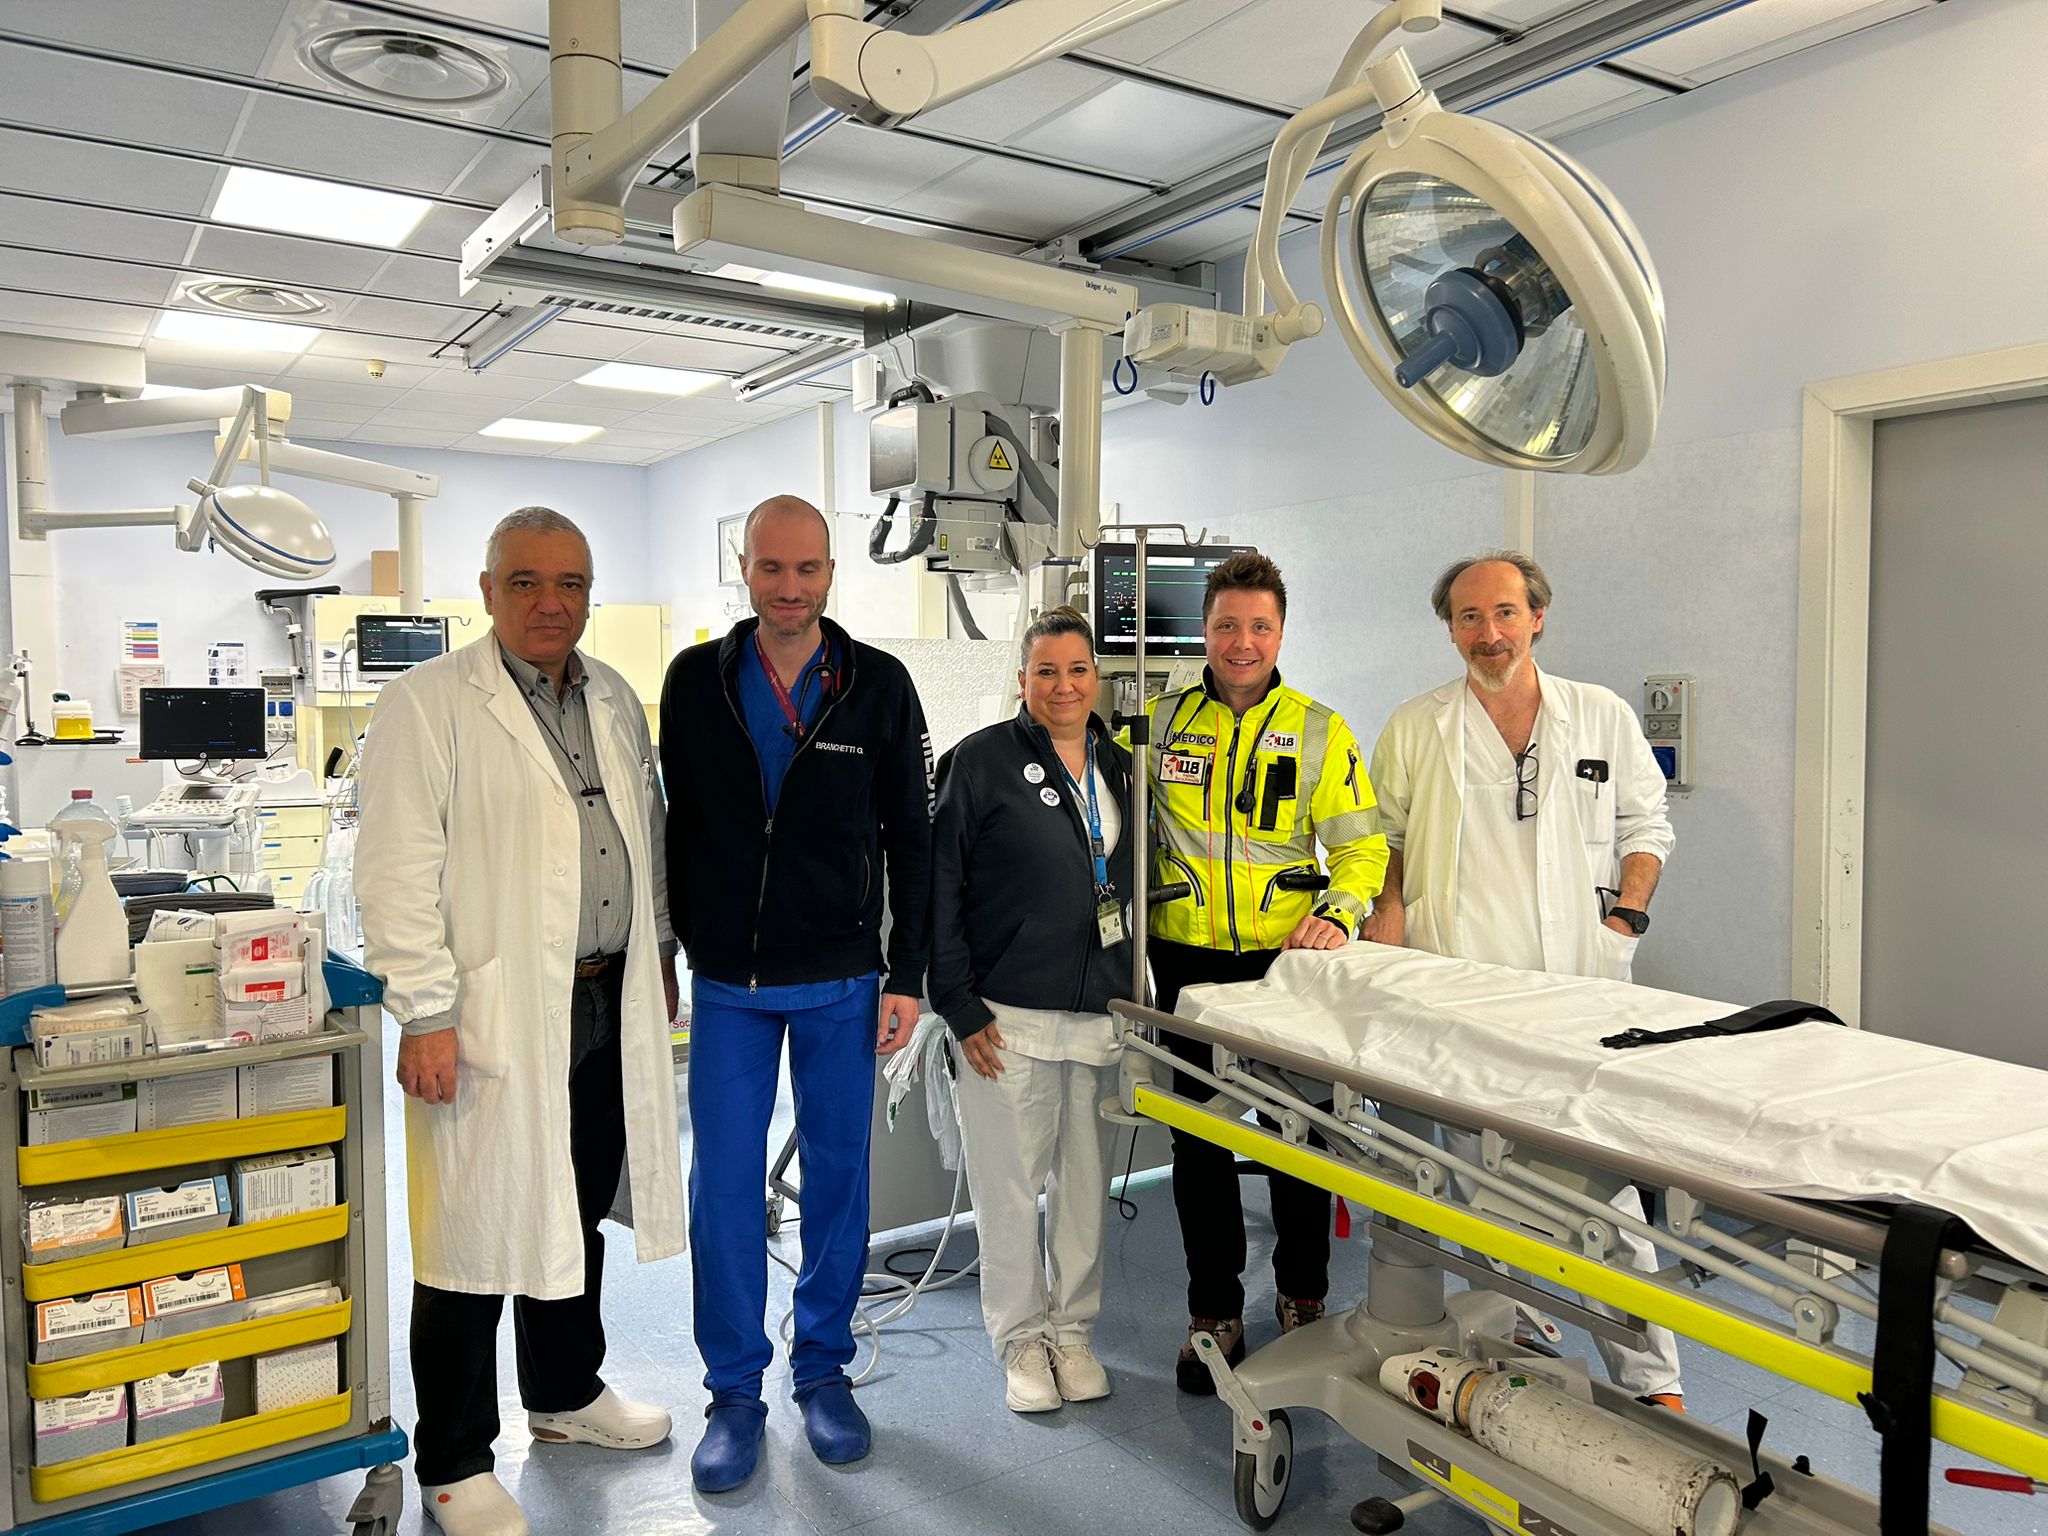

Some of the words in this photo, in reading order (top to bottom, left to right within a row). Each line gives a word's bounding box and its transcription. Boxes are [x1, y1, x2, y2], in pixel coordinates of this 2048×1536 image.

[1172, 731, 1216, 745] MEDICO
[1277, 735, 1295, 747] 118
[1177, 759, 1200, 775] 118
[37, 1209, 52, 1219] 2-0
